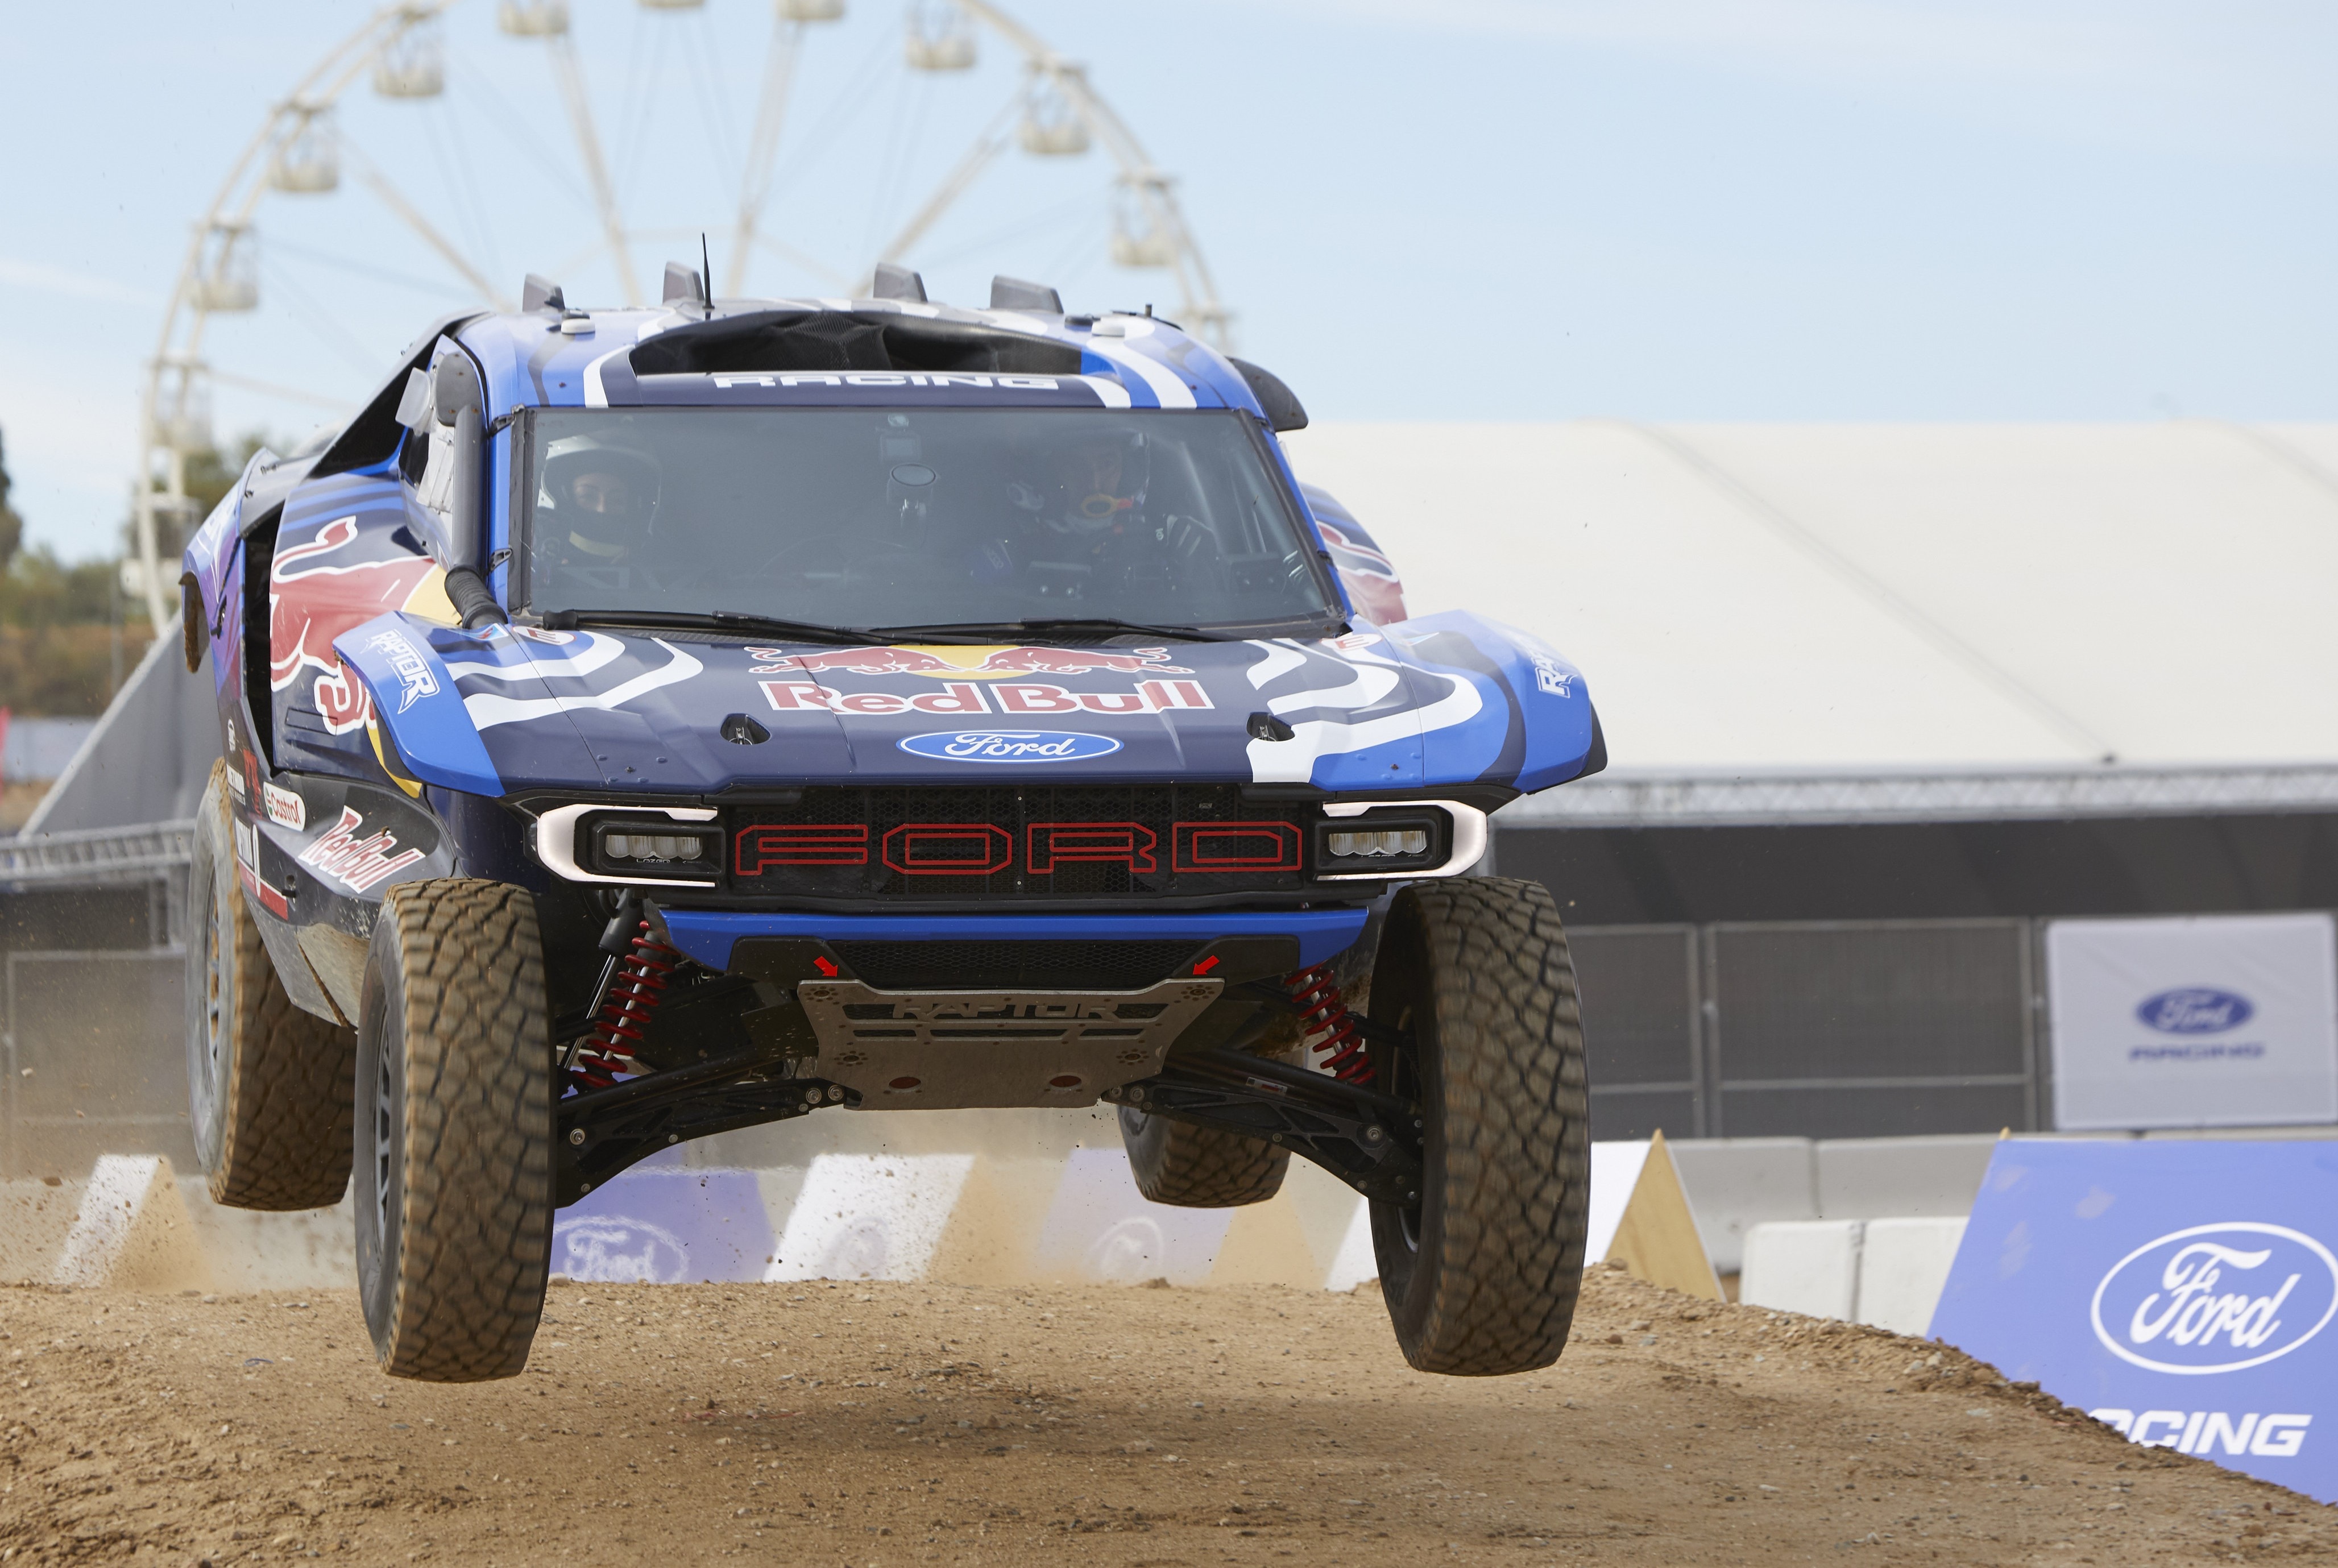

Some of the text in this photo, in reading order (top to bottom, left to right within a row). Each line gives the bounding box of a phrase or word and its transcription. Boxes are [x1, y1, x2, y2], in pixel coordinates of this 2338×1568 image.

[714, 375, 1059, 391] RACING
[359, 628, 440, 714] RAPTOR
[758, 679, 1215, 715] Red Bull
[944, 732, 1076, 757] Ford
[271, 791, 301, 824] Castrol
[735, 822, 1303, 876] FORD
[892, 1003, 1119, 1022] RAPTOR
[2130, 1242, 2302, 1348] Ford
